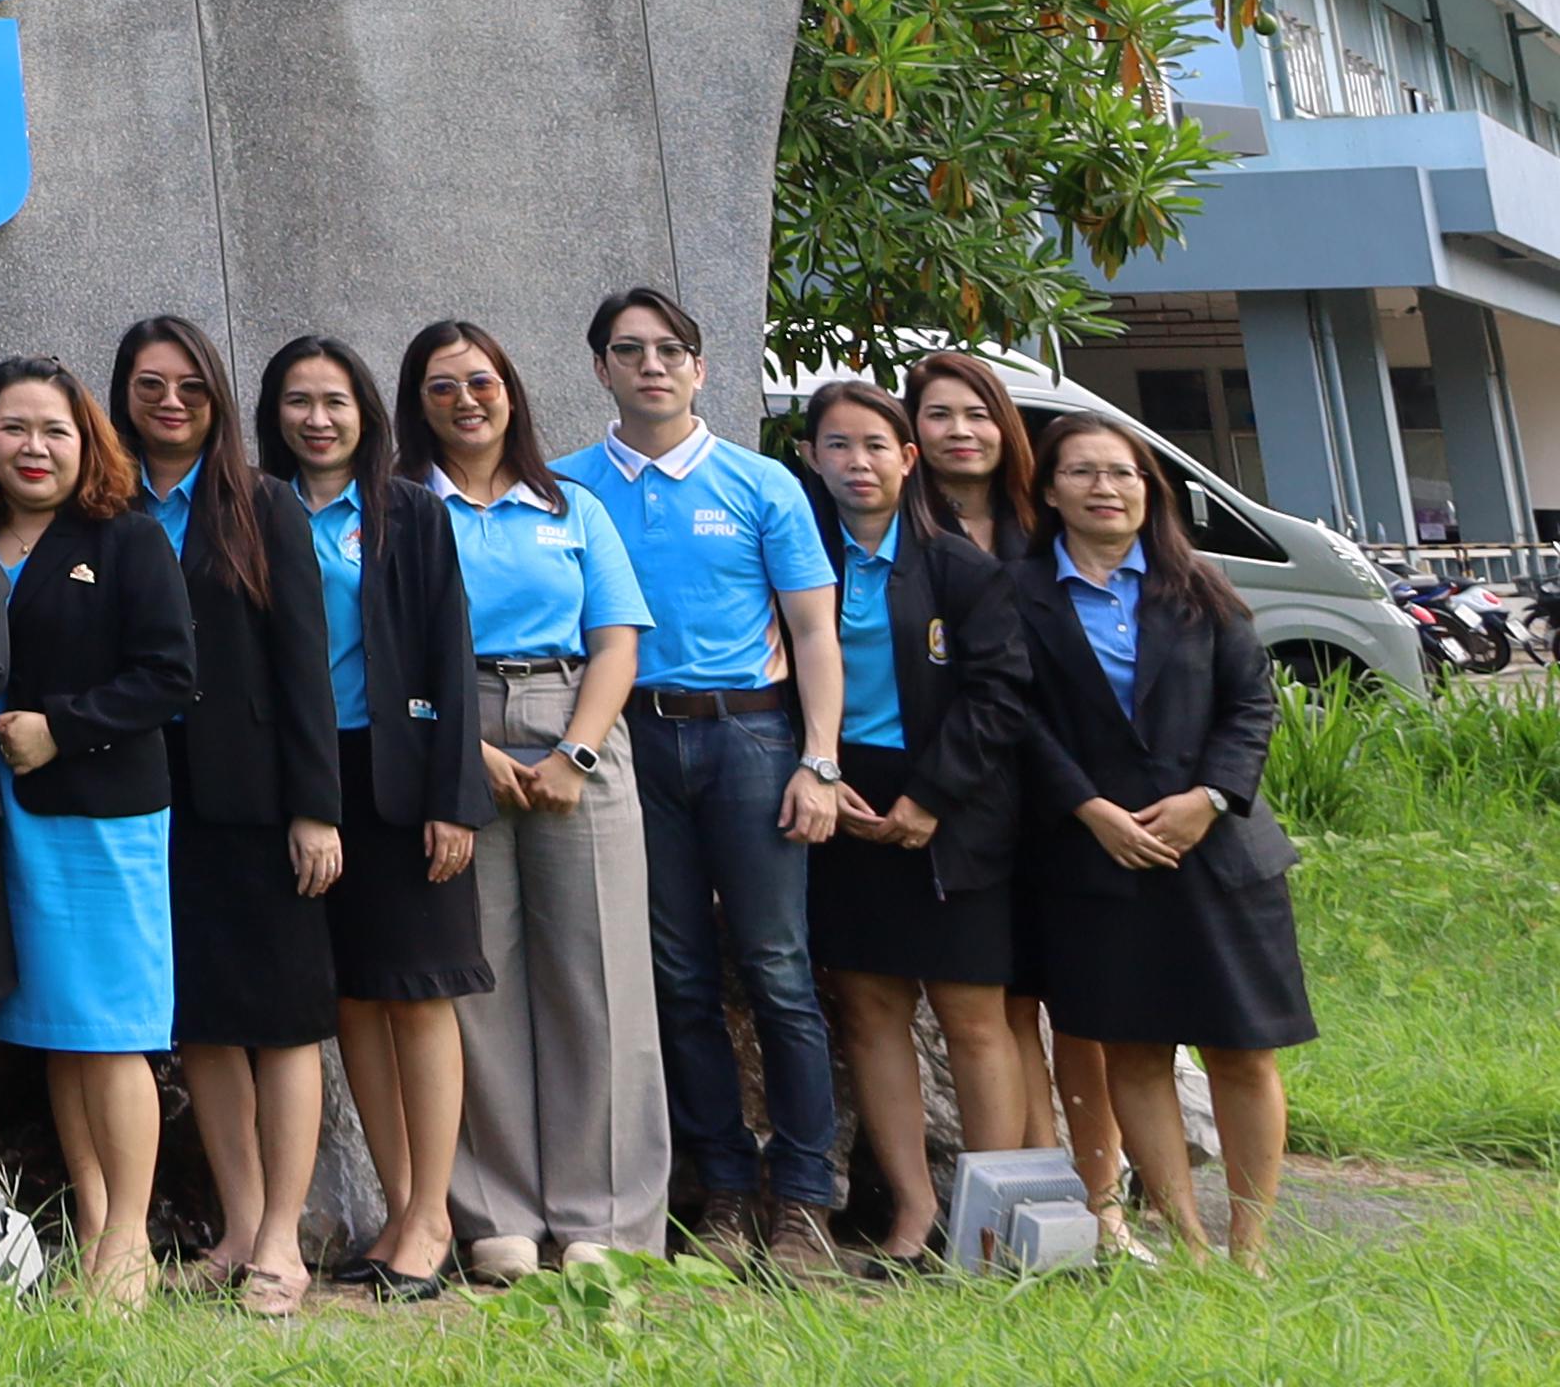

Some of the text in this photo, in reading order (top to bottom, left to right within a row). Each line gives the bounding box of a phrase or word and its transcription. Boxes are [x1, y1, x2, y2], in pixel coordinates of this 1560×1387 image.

[694, 510, 727, 522] EDU
[536, 525, 568, 538] EDU
[693, 522, 738, 536] KPRU
